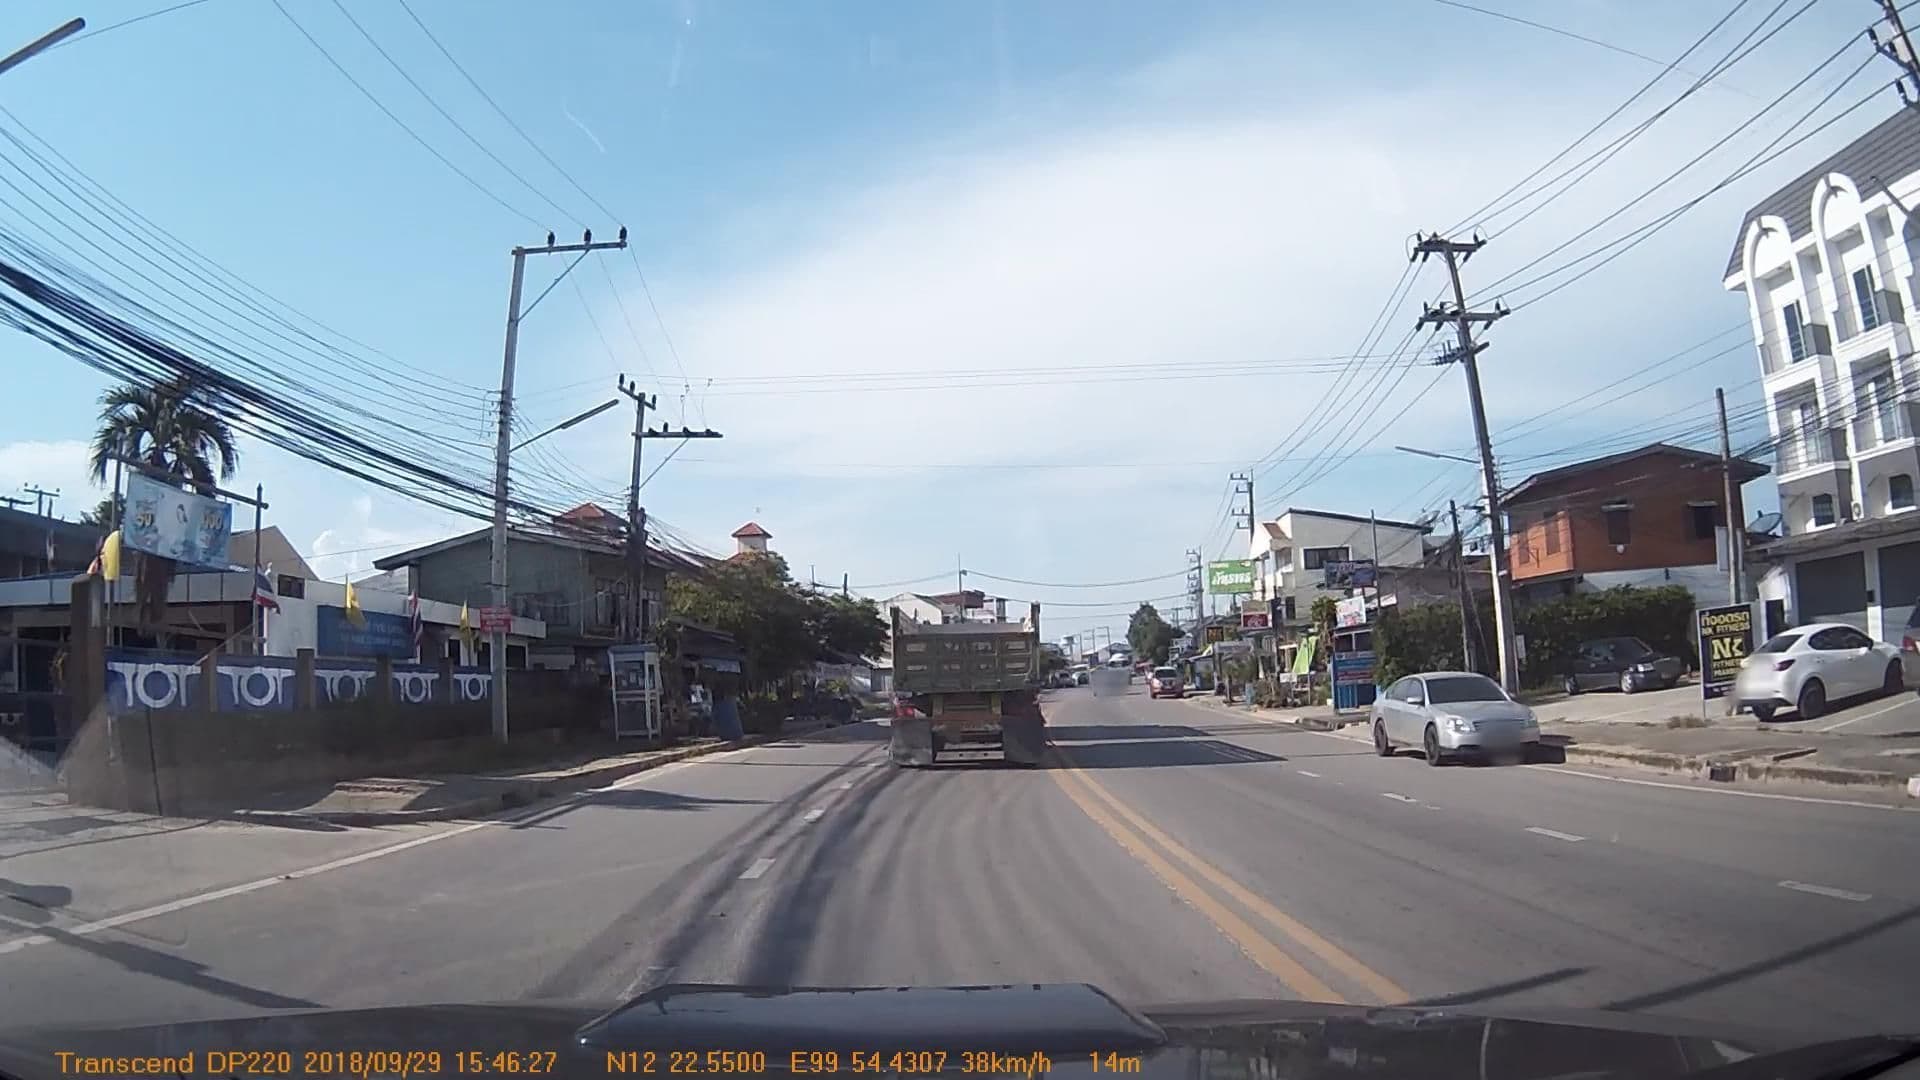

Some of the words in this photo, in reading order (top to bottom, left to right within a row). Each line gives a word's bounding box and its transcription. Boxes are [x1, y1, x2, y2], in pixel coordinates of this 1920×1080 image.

[1716, 621, 1750, 633] FITNESS
[107, 661, 202, 708] TOT
[216, 665, 295, 706] TOT
[453, 673, 492, 700] TOT
